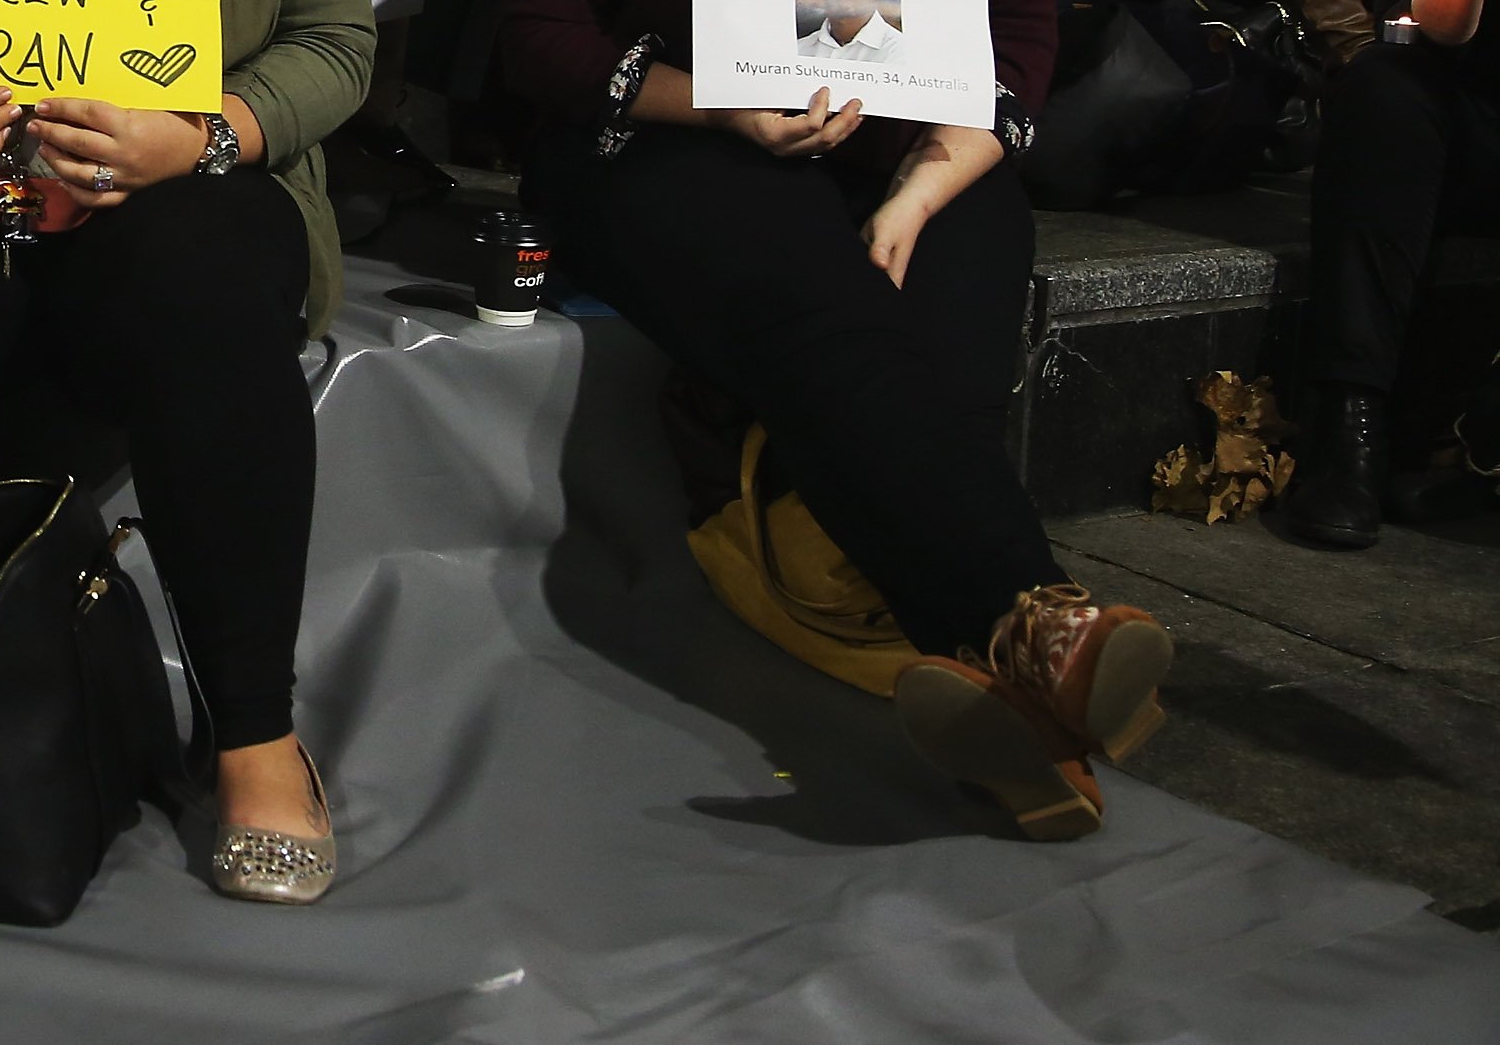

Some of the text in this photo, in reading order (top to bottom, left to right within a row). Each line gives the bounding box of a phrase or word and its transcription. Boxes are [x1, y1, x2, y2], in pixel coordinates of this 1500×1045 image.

[735, 61, 969, 92] Myuran Sukumaran, 34, Australia
